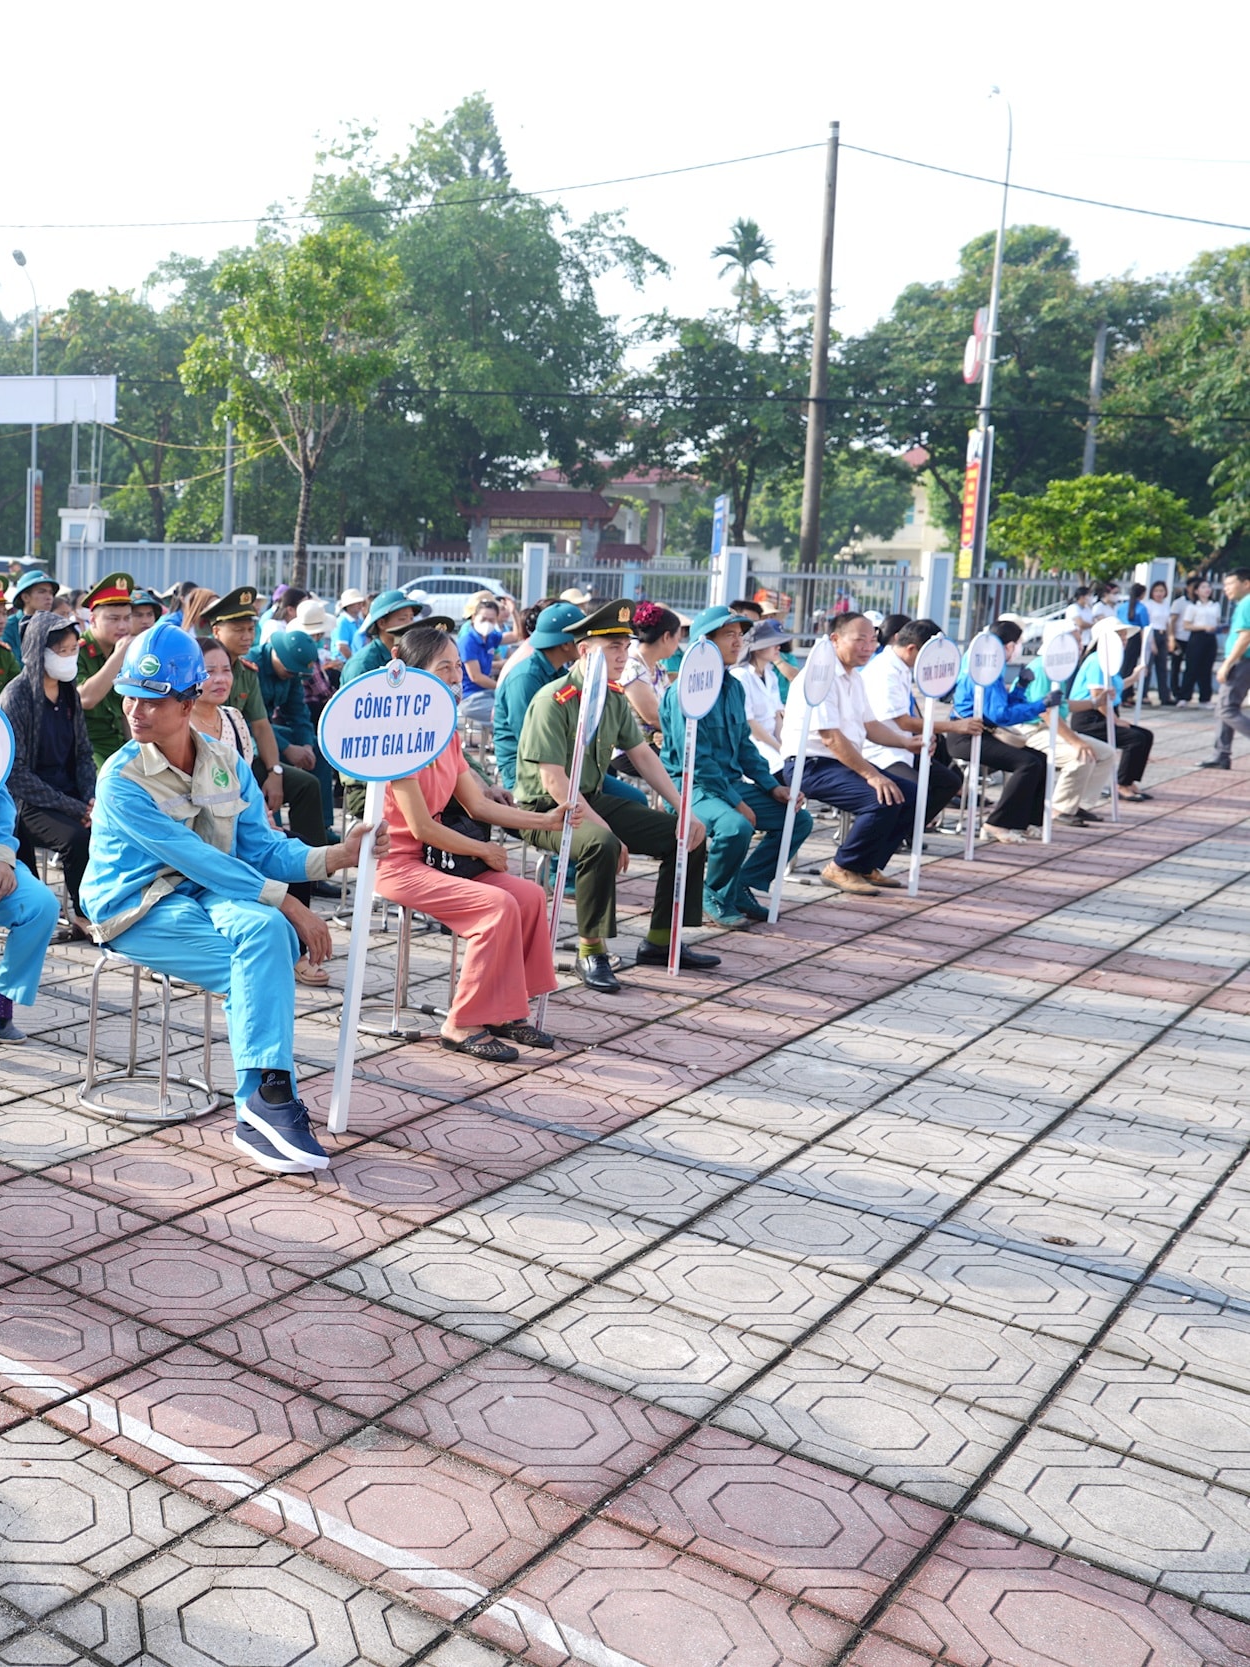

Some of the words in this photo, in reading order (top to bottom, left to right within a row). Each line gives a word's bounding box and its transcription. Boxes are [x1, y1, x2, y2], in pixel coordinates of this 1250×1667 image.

[688, 668, 704, 693] CÔNG
[705, 670, 714, 690] AN
[354, 691, 392, 719] CÔNG
[396, 695, 411, 717] TY
[413, 694, 431, 716] CP
[341, 735, 379, 759] MTĐT
[382, 733, 403, 756] GIA
[407, 728, 435, 753] LÂM
